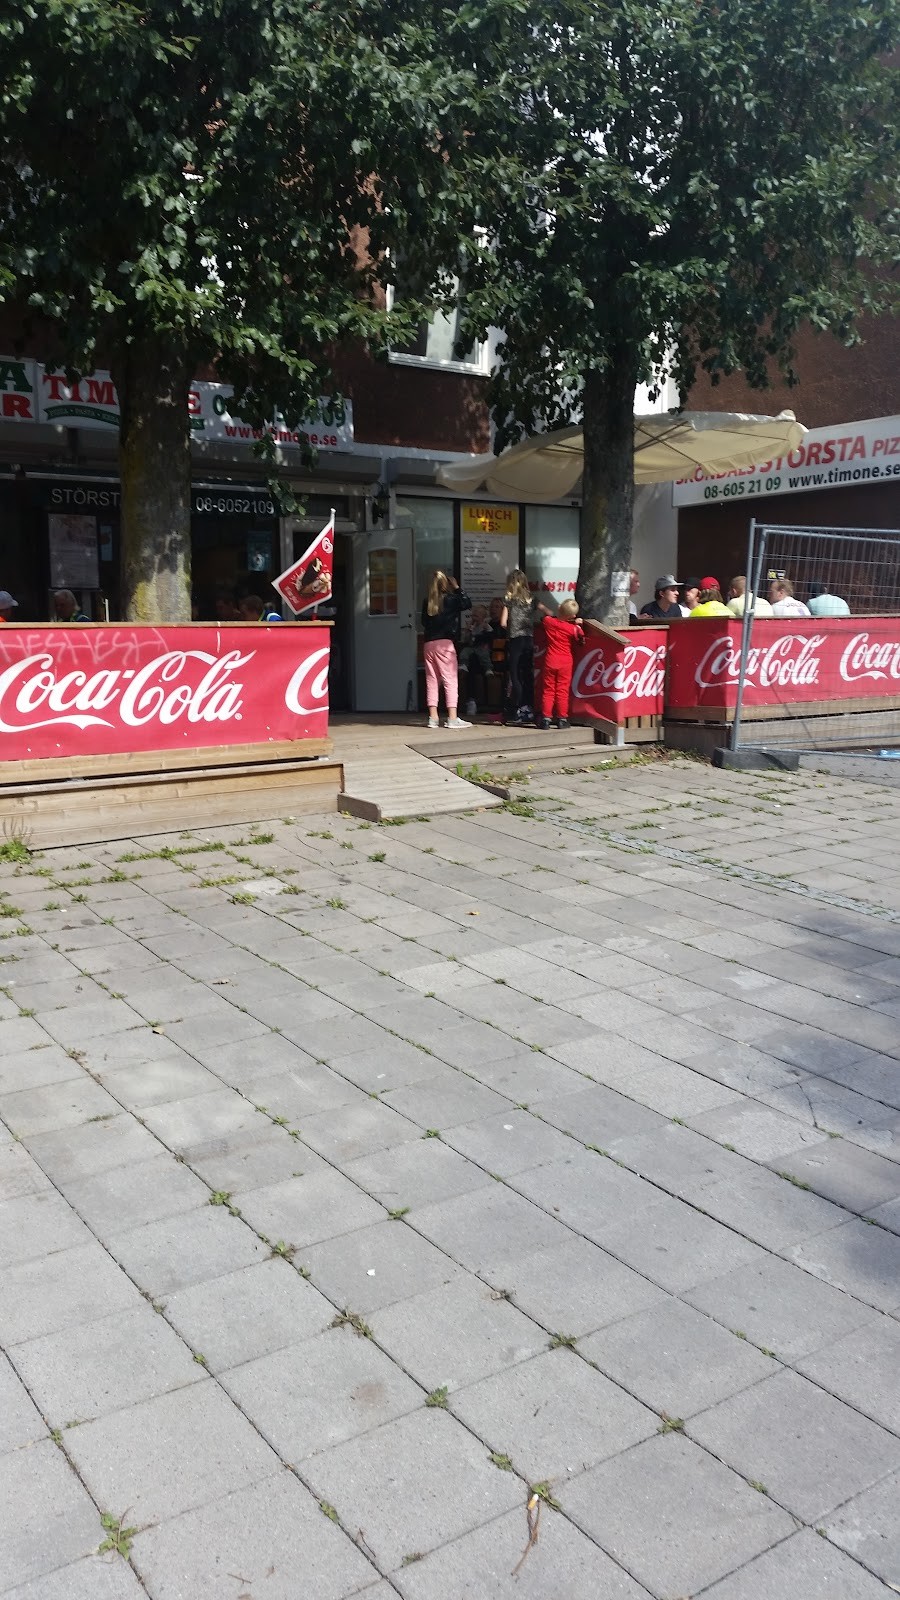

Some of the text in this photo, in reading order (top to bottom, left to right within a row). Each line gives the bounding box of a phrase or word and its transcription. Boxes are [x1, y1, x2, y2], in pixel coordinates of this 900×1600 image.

[224, 424, 338, 446] wwwimoe.se
[759, 435, 866, 473] STÖRSTA
[704, 464, 900, 499] 08-605 21 09 www.timone.se
[51, 486, 121, 507] STÖRST
[195, 496, 275, 515] 08-6052109
[468, 507, 512, 521] LUNCH
[695, 635, 828, 688] Coca-Cola
[0, 650, 256, 732] Coca-Cola
